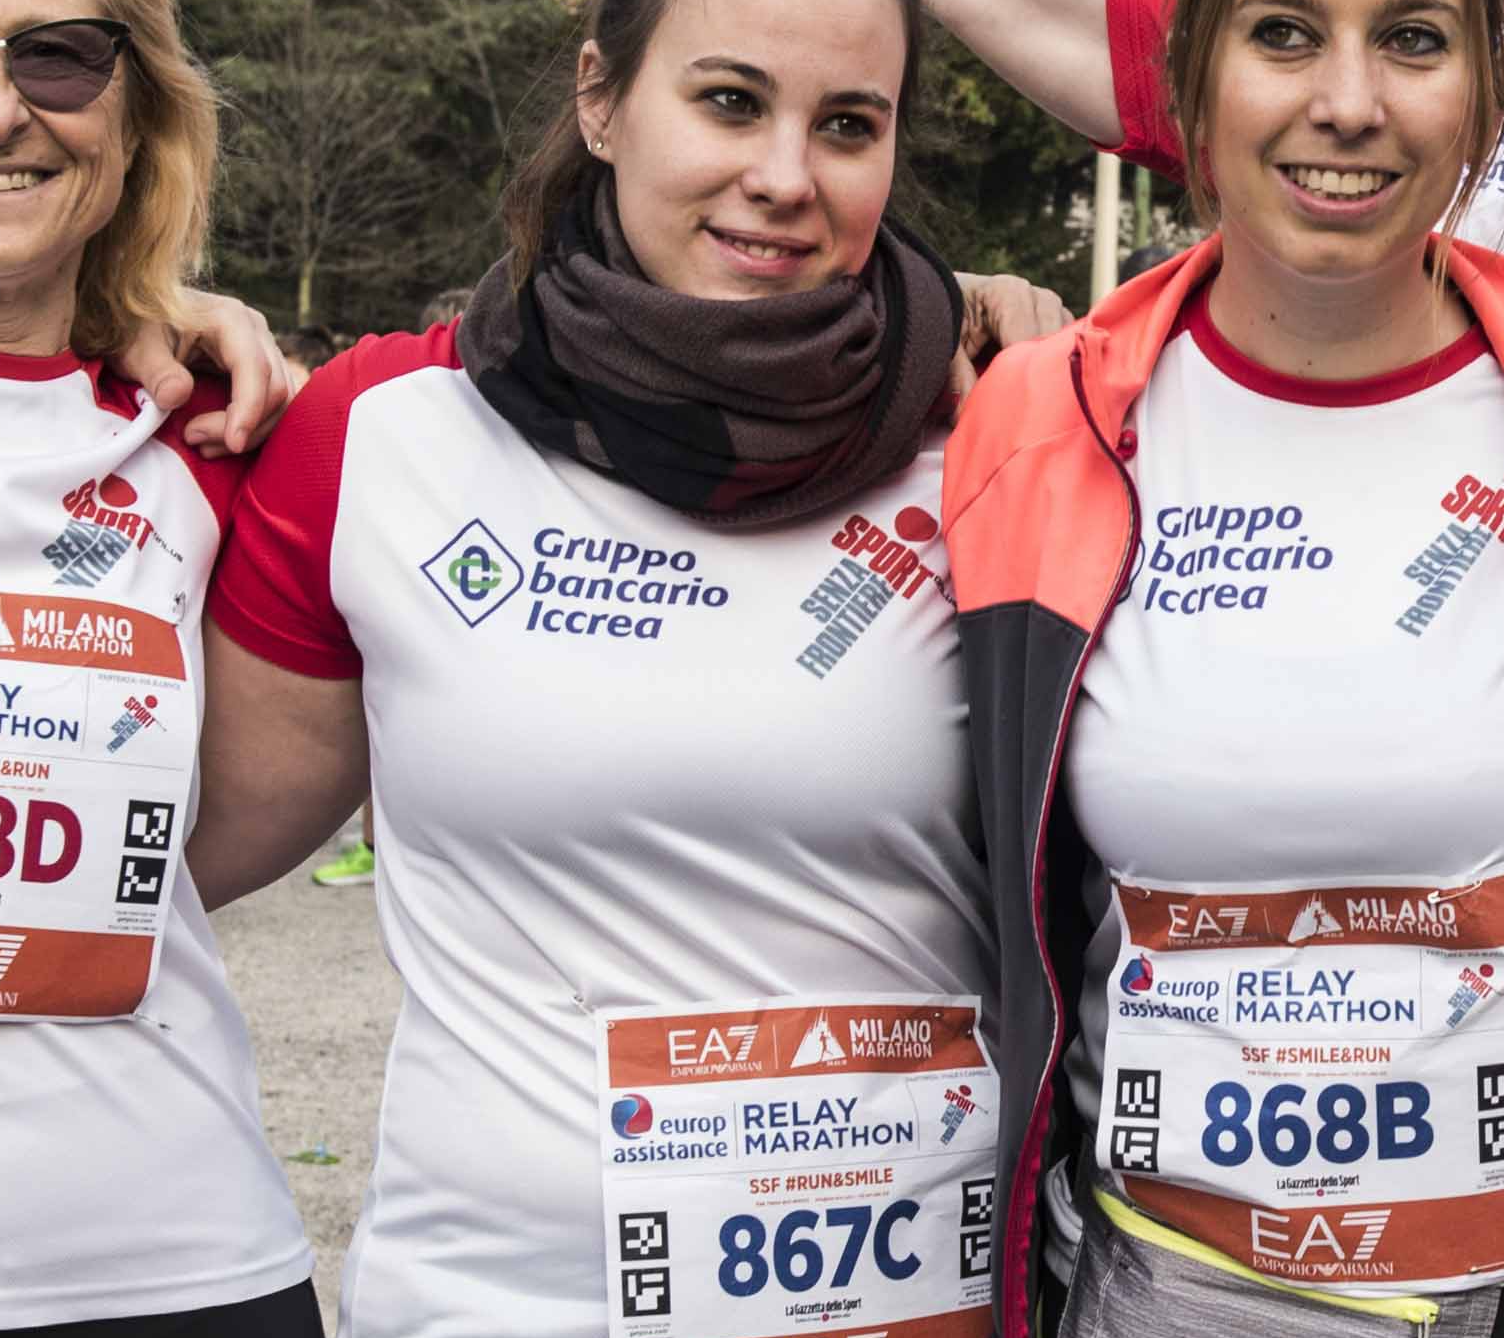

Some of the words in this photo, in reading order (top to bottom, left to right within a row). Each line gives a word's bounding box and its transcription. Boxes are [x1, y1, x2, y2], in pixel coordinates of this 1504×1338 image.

[63, 478, 154, 551] SPORT
[1156, 505, 1302, 543] Gruppo
[533, 528, 696, 573] Gruppo
[831, 513, 935, 600] SPORT
[1150, 536, 1334, 579] bancario
[1402, 523, 1472, 587] SENZA
[528, 562, 729, 608] bancario
[799, 558, 873, 625] SENZA
[1144, 579, 1268, 615] Iccrea
[1396, 526, 1494, 637] FRONTIERE
[22, 608, 133, 641] MILANO
[526, 601, 662, 640] Iccrea
[796, 574, 897, 680] FRONTIERE
[22, 632, 133, 657] MARATHON
[123, 695, 156, 728] SPORT
[1346, 897, 1455, 926] MILANO
[1350, 918, 1458, 938] MARATHON
[1157, 978, 1220, 998] europ
[1236, 970, 1355, 996] RELAY
[1458, 966, 1494, 999] SPORT
[1119, 999, 1219, 1022] assistance
[1236, 1000, 1415, 1022] MARATHON
[668, 1025, 758, 1065] EA7
[849, 1018, 931, 1045] MILANO
[853, 1042, 932, 1058] MARATHON
[1242, 1047, 1270, 1062] SSF
[1276, 1046, 1390, 1063] #SMILE&RUN
[743, 1097, 858, 1130] RELAY
[945, 1088, 975, 1114] SPORT
[660, 1114, 727, 1136] europ
[744, 1120, 913, 1155] MARATHON
[1201, 1081, 1435, 1166] 868B
[613, 1140, 728, 1163] assistance
[750, 1177, 781, 1194] SSF
[786, 1168, 893, 1191] #RUN&SMILE
[718, 1199, 922, 1297] 867C
[1250, 1209, 1392, 1261] EA7
[1253, 1258, 1317, 1277] EMPORIO
[1336, 1261, 1394, 1276] ARMANI
